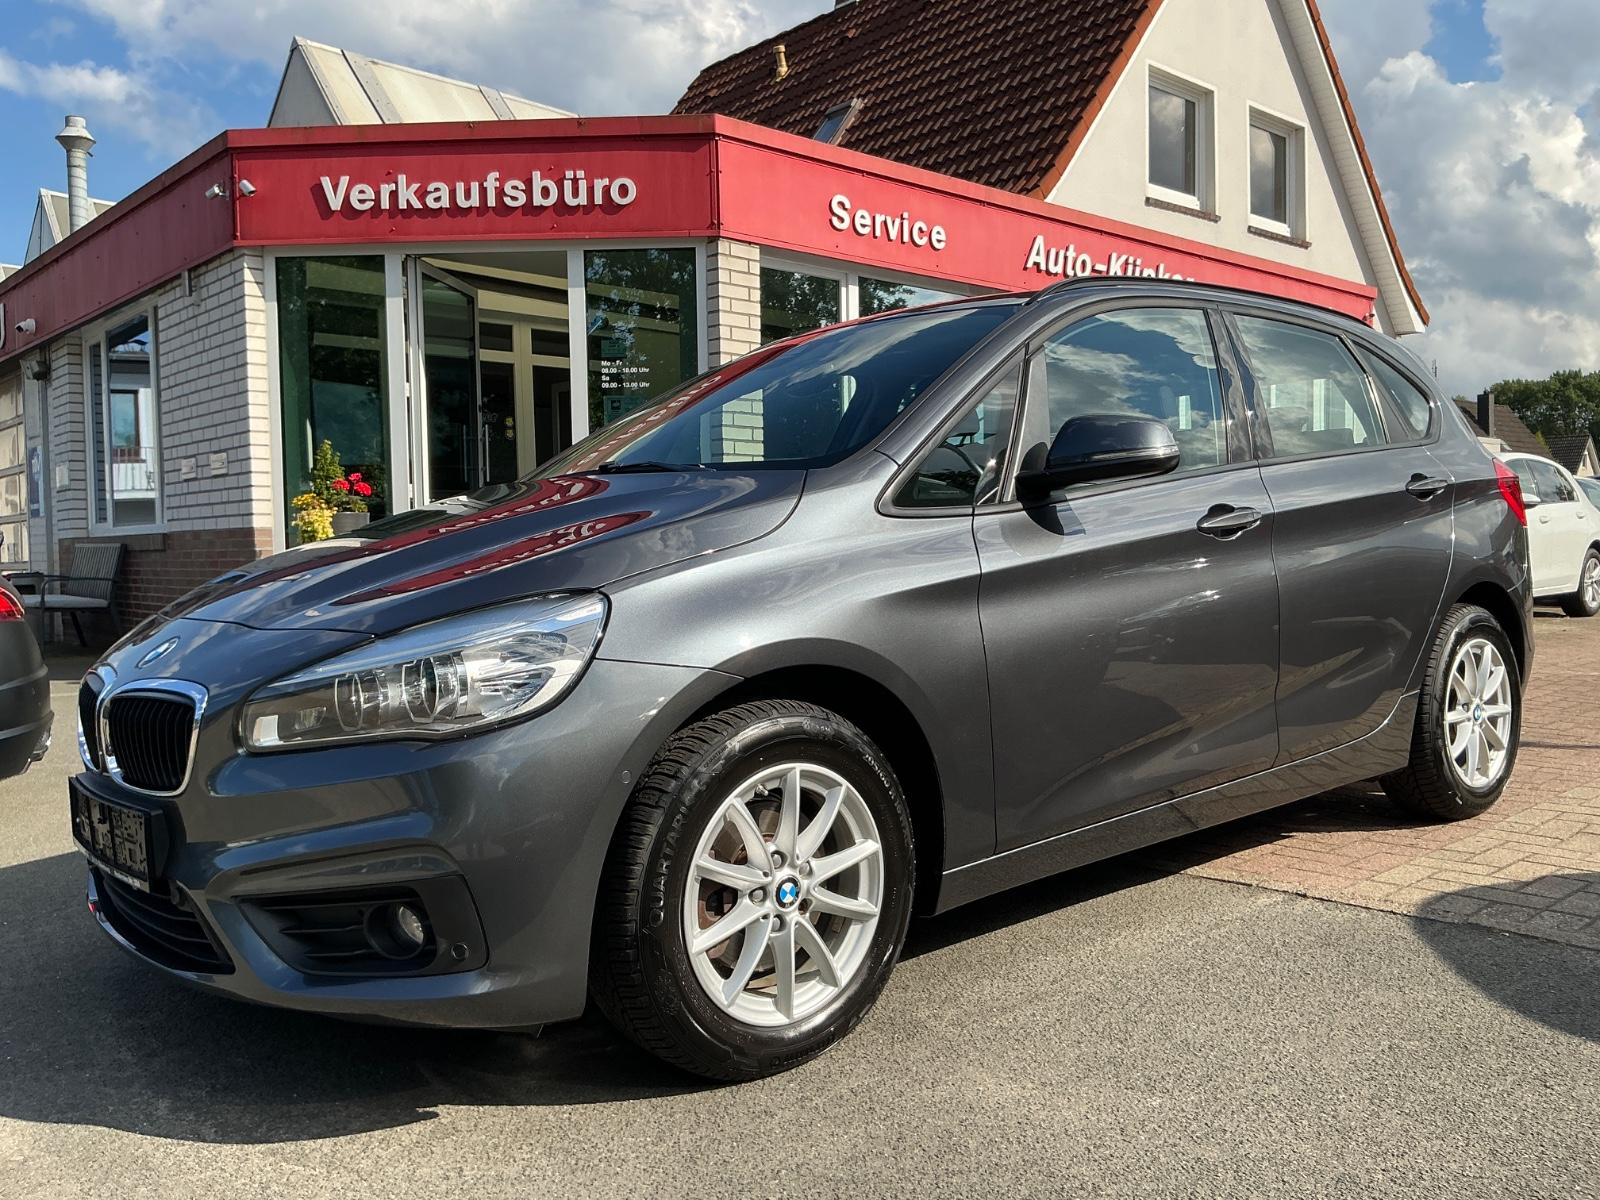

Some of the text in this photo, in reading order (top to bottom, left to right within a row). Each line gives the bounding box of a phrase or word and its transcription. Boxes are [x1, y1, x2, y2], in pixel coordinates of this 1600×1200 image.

[320, 170, 637, 211] Verkaufsbüro
[830, 194, 947, 250] Service
[1026, 234, 1195, 281] Auto-Kük
[648, 798, 691, 928] QUARTARI
